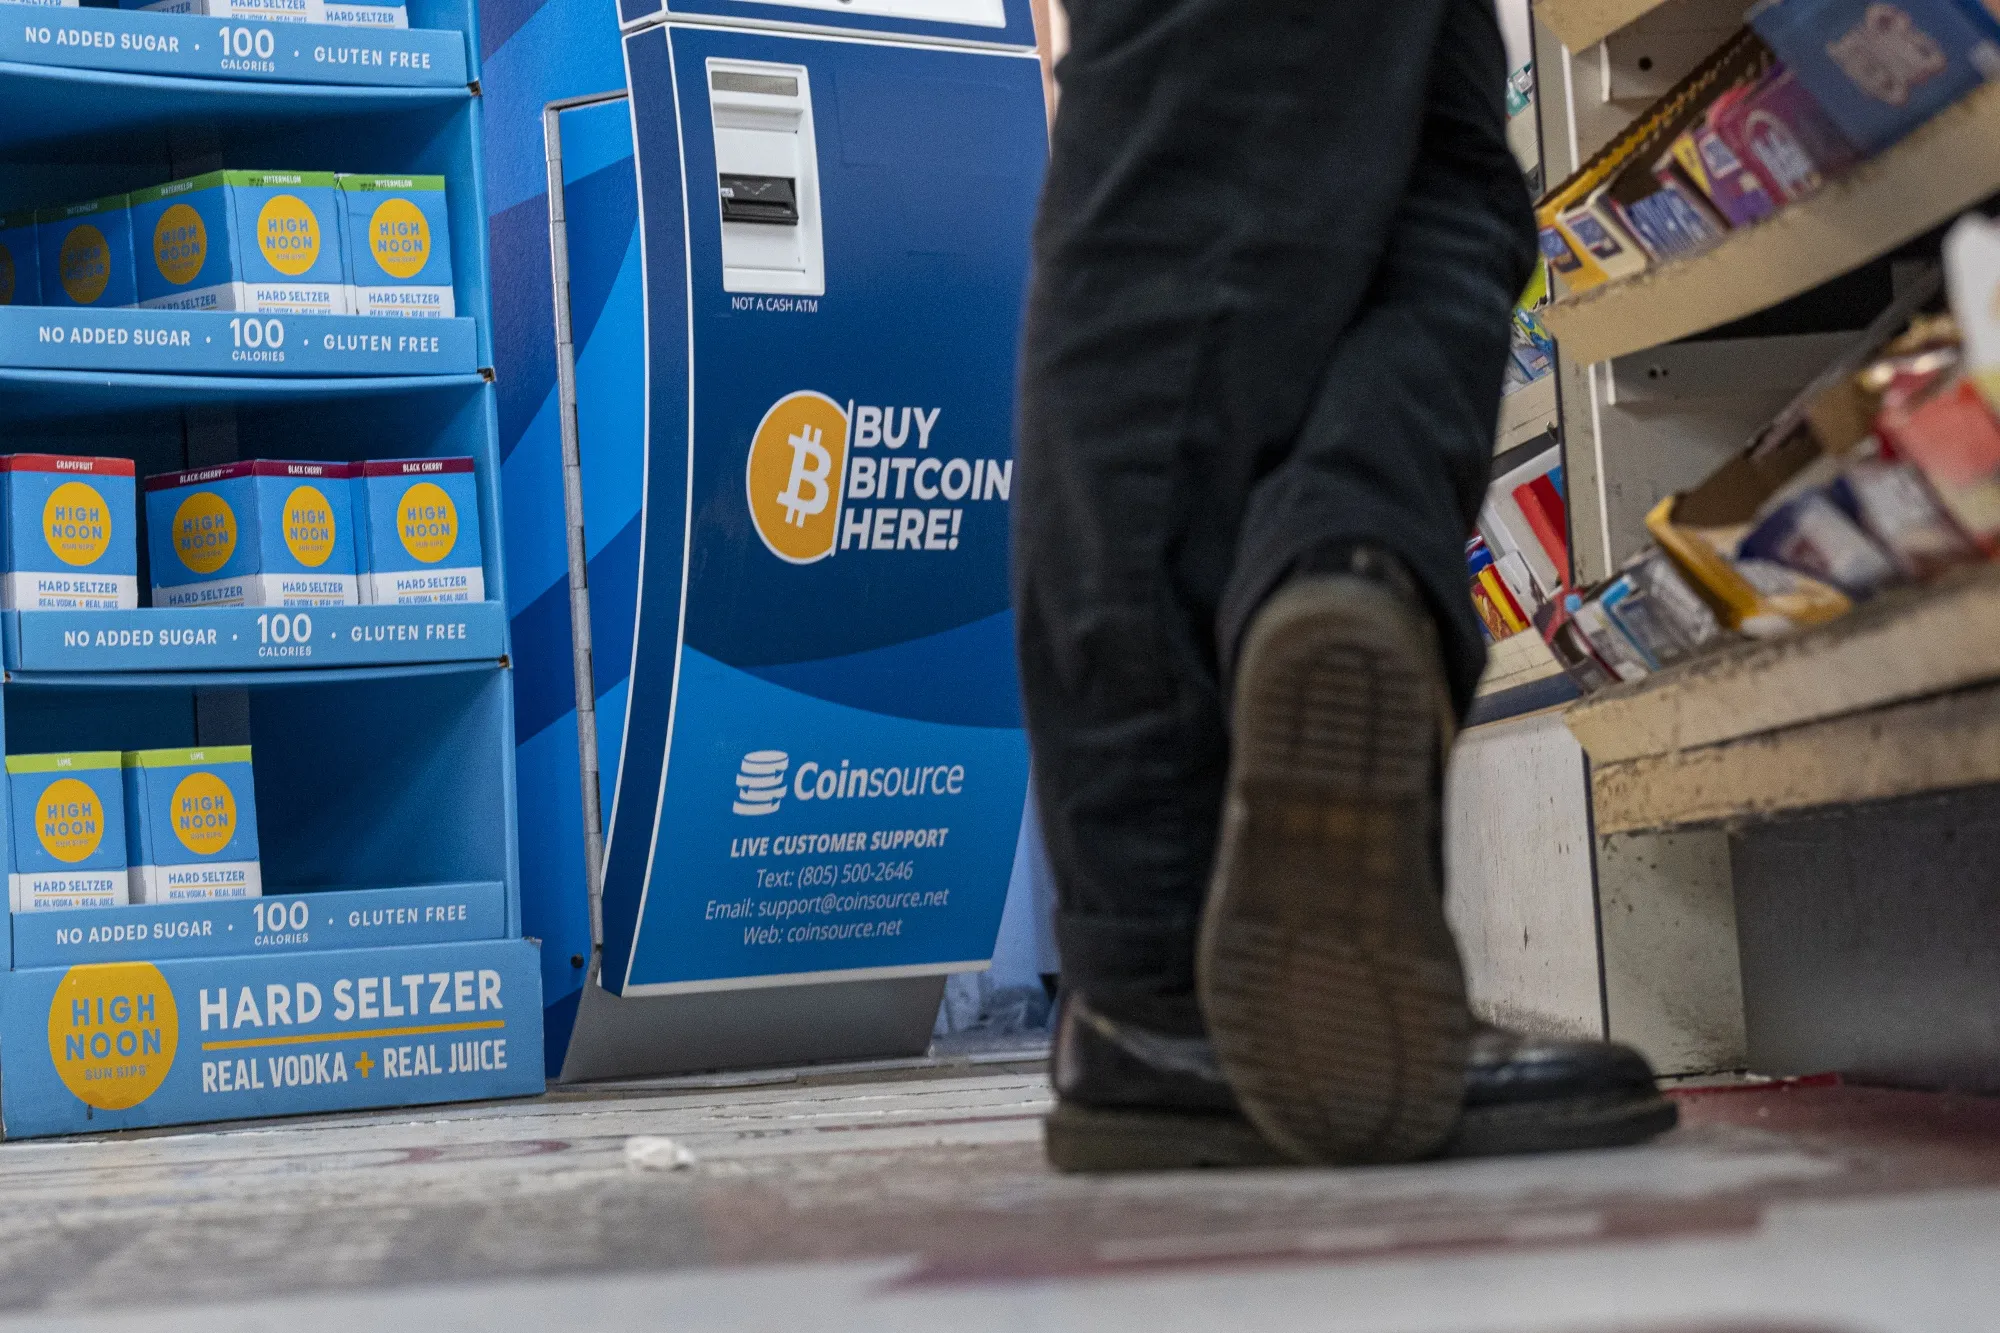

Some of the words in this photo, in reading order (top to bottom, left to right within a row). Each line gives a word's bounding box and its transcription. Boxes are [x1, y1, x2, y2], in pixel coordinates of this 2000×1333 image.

[326, 10, 354, 22] HARD
[355, 12, 394, 23] SELTZER
[25, 27, 51, 43] NO
[57, 29, 115, 49] ADDED
[121, 33, 179, 53] SUGAR
[219, 26, 275, 58] 100
[314, 46, 382, 66] GLUTEN
[389, 51, 431, 69] FREE
[221, 59, 275, 73] CALORIES
[267, 217, 309, 234] HIGH
[379, 221, 420, 236] HIGH
[265, 235, 313, 250] NOON
[377, 239, 424, 253] NOON
[257, 290, 286, 301] HARD
[288, 291, 330, 302] SELTZER
[368, 292, 398, 304] HARD
[400, 293, 440, 304] SELTZER
[731, 297, 754, 310] NOT
[756, 297, 764, 311] A
[766, 298, 793, 312] CASH
[795, 300, 818, 313] ATM
[39, 326, 65, 343] NO
[70, 327, 128, 344] ADDED
[133, 329, 190, 346] SUGAR
[229, 318, 284, 348] 100
[323, 334, 391, 351] GLUTEN
[399, 337, 439, 353] FREE
[232, 350, 285, 362] CALORIES
[853, 405, 941, 449] BUY
[56, 460, 93, 471] GRAPEFRUIT
[288, 465, 304, 474] BLACK
[304, 465, 323, 476] CHERRY
[402, 463, 420, 473] BLACK
[421, 462, 443, 472] CHERRY
[179, 472, 199, 484] BLACK
[200, 469, 222, 481] CHERRY
[847, 457, 1013, 500] BITCOIN
[55, 506, 100, 522] HIGH
[291, 509, 326, 523] HIGH
[407, 506, 447, 521] HIGH
[183, 513, 225, 533] HIGH
[405, 523, 451, 538] NOON
[840, 508, 963, 550] HERE!
[52, 524, 102, 540] NOON
[181, 530, 229, 550] NOON
[290, 526, 329, 541] NOON
[38, 580, 70, 593] HARD
[73, 581, 118, 594] SELTZER
[282, 581, 307, 593] HARD
[309, 582, 344, 593] SELTZER
[397, 578, 426, 590] HARD
[427, 575, 467, 589] SELTZER
[39, 598, 55, 607] REAL
[56, 599, 77, 608] VODKA
[85, 600, 101, 609] REAL
[103, 600, 119, 609] JUICE
[168, 592, 199, 606] HARD
[201, 585, 244, 601] SELTZER
[257, 613, 312, 644] 100
[351, 625, 419, 642] GLUTEN
[426, 624, 466, 640] FREE
[64, 630, 90, 647] NO
[95, 630, 154, 647] ADDED
[159, 628, 217, 645] SUGAR
[258, 645, 312, 657] CALORIES
[57, 758, 72, 767] LIME
[190, 752, 205, 761] LIME
[794, 759, 965, 801] Coinsource
[47, 803, 92, 819] HIGH
[181, 796, 225, 812] HIGH
[45, 821, 96, 837] NOON
[179, 813, 229, 829] NOON
[730, 837, 770, 858] LIVE
[773, 832, 867, 856] CUSTOMER
[870, 827, 949, 850] SUPPORT
[168, 873, 200, 884] HARD
[202, 871, 245, 882] SELTZER
[757, 868, 794, 888] Text:
[797, 864, 838, 890] (805)
[841, 860, 914, 884] 500-2646
[34, 880, 66, 892] HARD
[69, 880, 113, 892] SELTZER
[169, 890, 186, 899] REAL
[187, 889, 207, 898] VODKA
[214, 888, 231, 898] REAL
[34, 899, 50, 908] REAL
[52, 898, 73, 907] VODKA
[82, 898, 98, 907] REAL
[705, 897, 755, 920] Email:
[758, 888, 950, 921] support@coinsource.net
[253, 901, 309, 932] 100
[349, 907, 418, 927] GLUTEN
[426, 905, 467, 922] FREE
[56, 928, 83, 945] NO
[88, 924, 148, 943] ADDED
[153, 920, 212, 939] SUGAR
[254, 933, 308, 946] CALORIES
[744, 924, 783, 945] Web:
[787, 919, 903, 943] coinsource.net
[200, 982, 322, 1031] HARD
[333, 969, 503, 1021] SELTZER
[72, 994, 155, 1027] HIGH
[65, 1028, 161, 1061] NOON
[85, 1067, 113, 1081] SUN
[117, 1065, 147, 1079] SIPS
[202, 1058, 264, 1093] REAL
[269, 1052, 348, 1089] VODKA
[383, 1045, 442, 1079] REAL
[448, 1039, 508, 1073] JUICE
